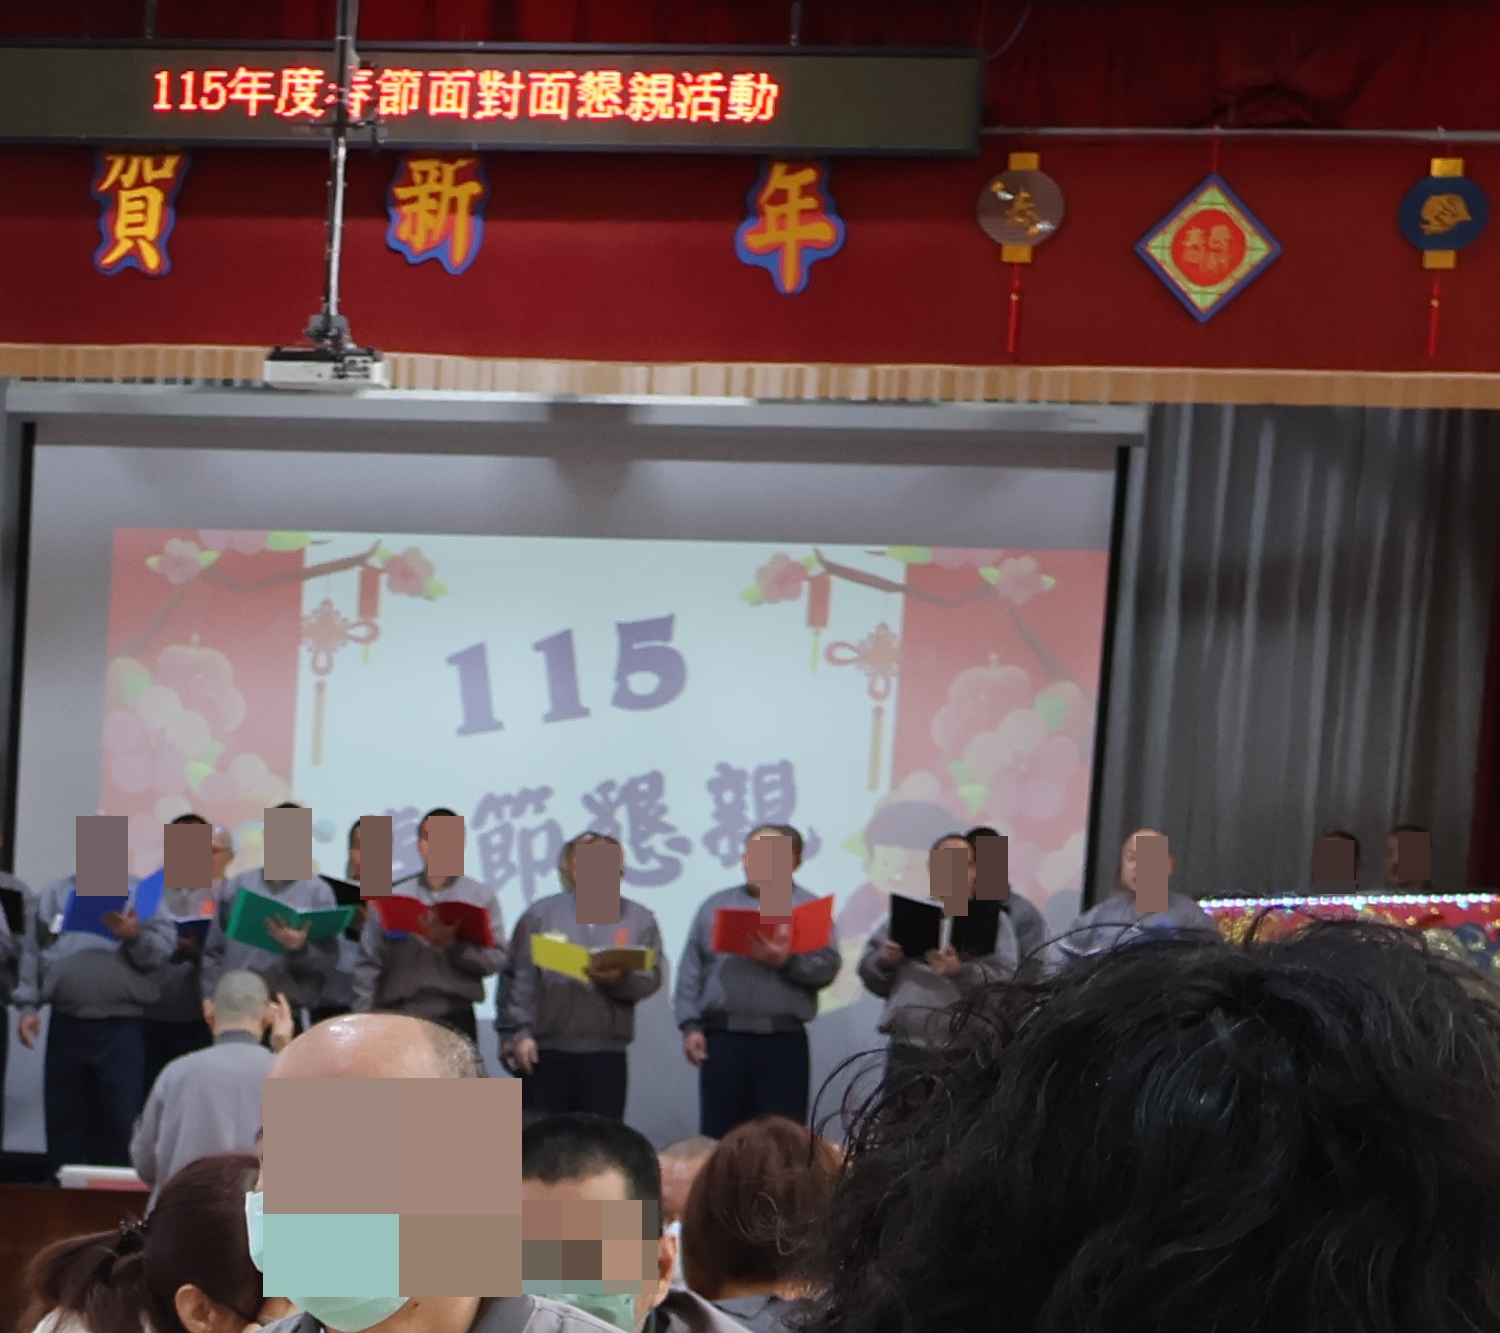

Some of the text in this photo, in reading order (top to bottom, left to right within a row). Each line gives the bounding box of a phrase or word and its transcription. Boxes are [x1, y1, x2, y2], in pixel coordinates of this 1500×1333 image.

[393, 158, 484, 266] 新
[745, 161, 834, 291] 年
[446, 612, 688, 738] 115
[366, 758, 822, 904] 節懇親
